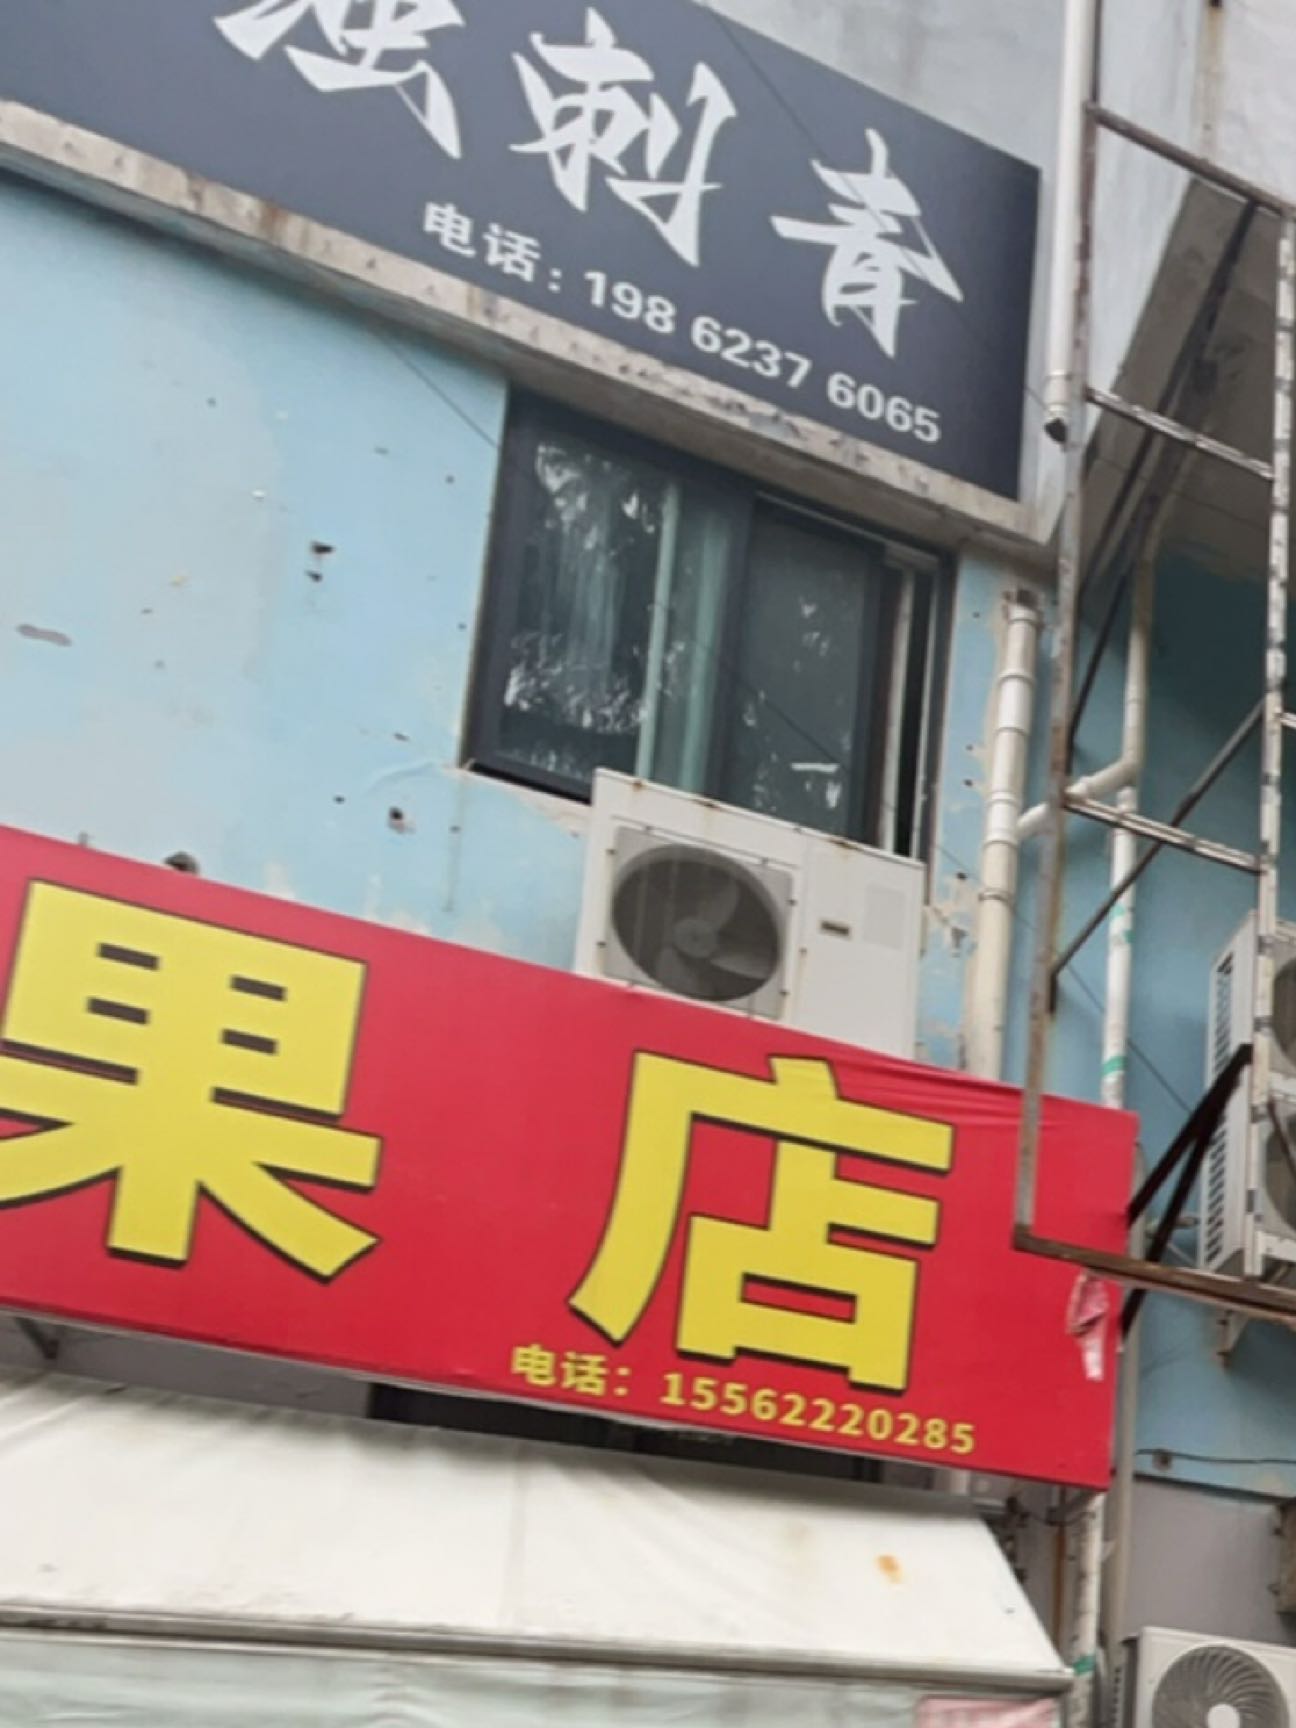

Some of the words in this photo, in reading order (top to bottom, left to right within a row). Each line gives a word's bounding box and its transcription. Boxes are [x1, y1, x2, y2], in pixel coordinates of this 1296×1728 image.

[691, 315, 812, 389] 6237
[826, 373, 941, 444] 6065
[0, 877, 954, 1395] 果店
